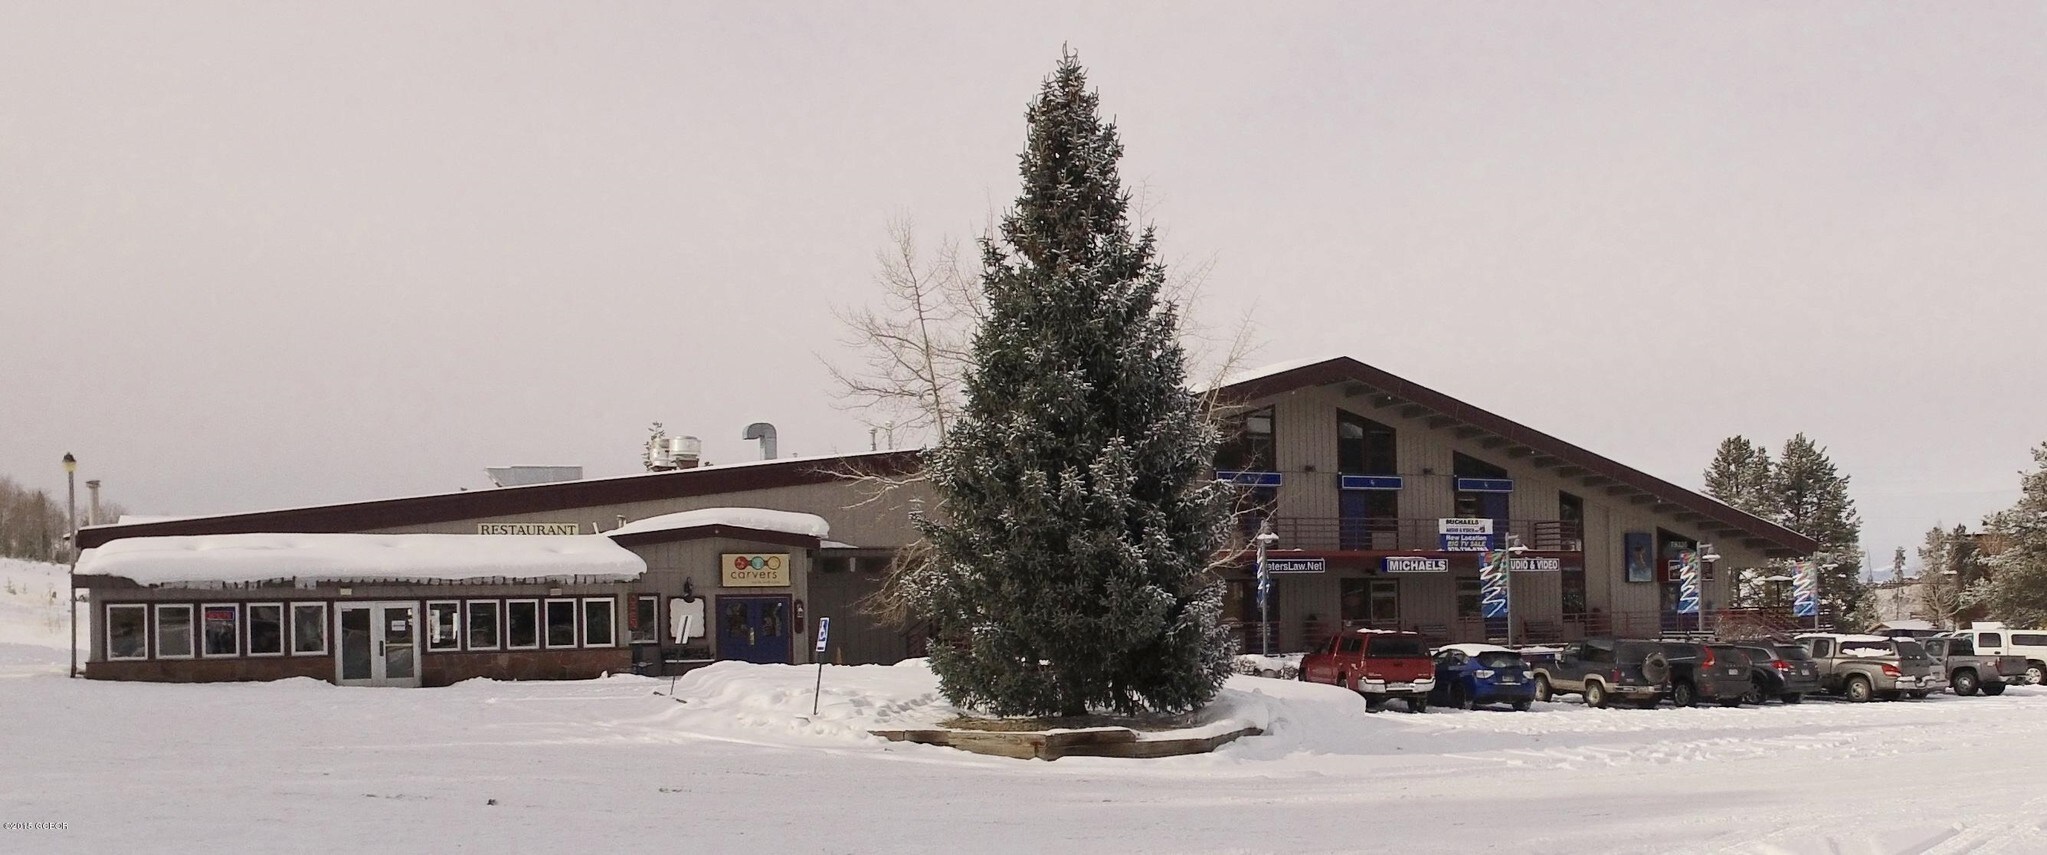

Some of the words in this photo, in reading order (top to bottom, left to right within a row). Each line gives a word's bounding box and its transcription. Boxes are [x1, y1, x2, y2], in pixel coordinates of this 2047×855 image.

[480, 524, 577, 536] RESTAURANT
[1267, 561, 1323, 571] etersLaw.Net
[1389, 560, 1446, 571] MICHAELS
[1510, 560, 1529, 570] UDIO
[1530, 560, 1536, 570] &
[1537, 560, 1558, 570] VIDEO
[730, 571, 777, 579] carvers
